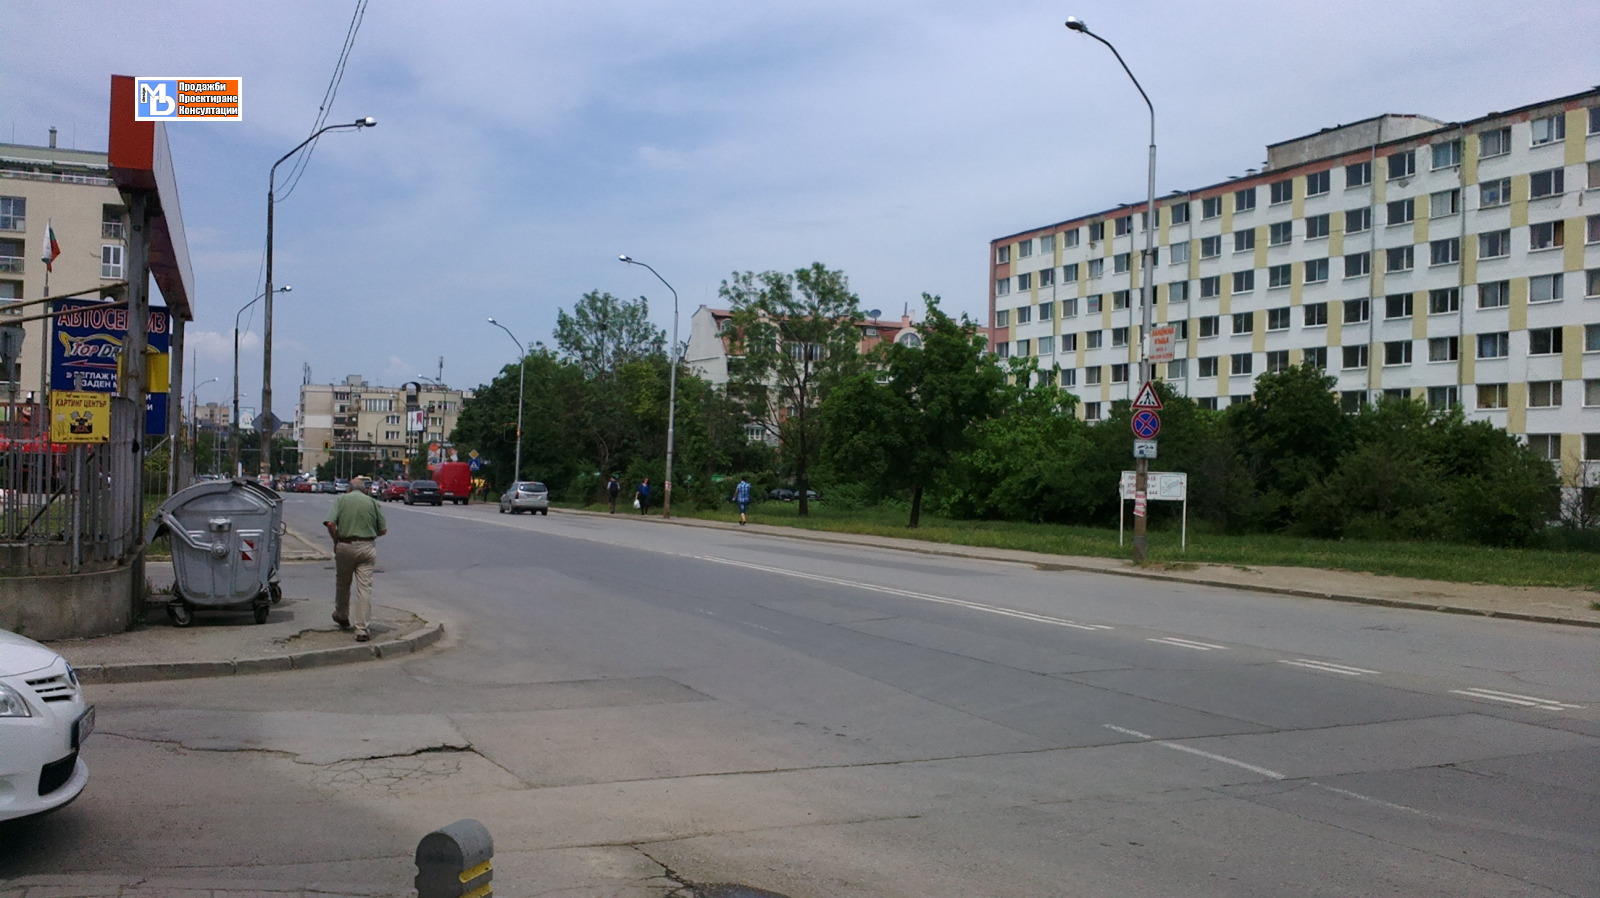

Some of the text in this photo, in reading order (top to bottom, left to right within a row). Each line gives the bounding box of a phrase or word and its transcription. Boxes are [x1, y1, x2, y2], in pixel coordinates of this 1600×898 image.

[57, 304, 166, 334] АВТОСЕИЗ
[82, 380, 111, 388] ЗАДЕН
[84, 400, 107, 408] ЦЕНТЪР
